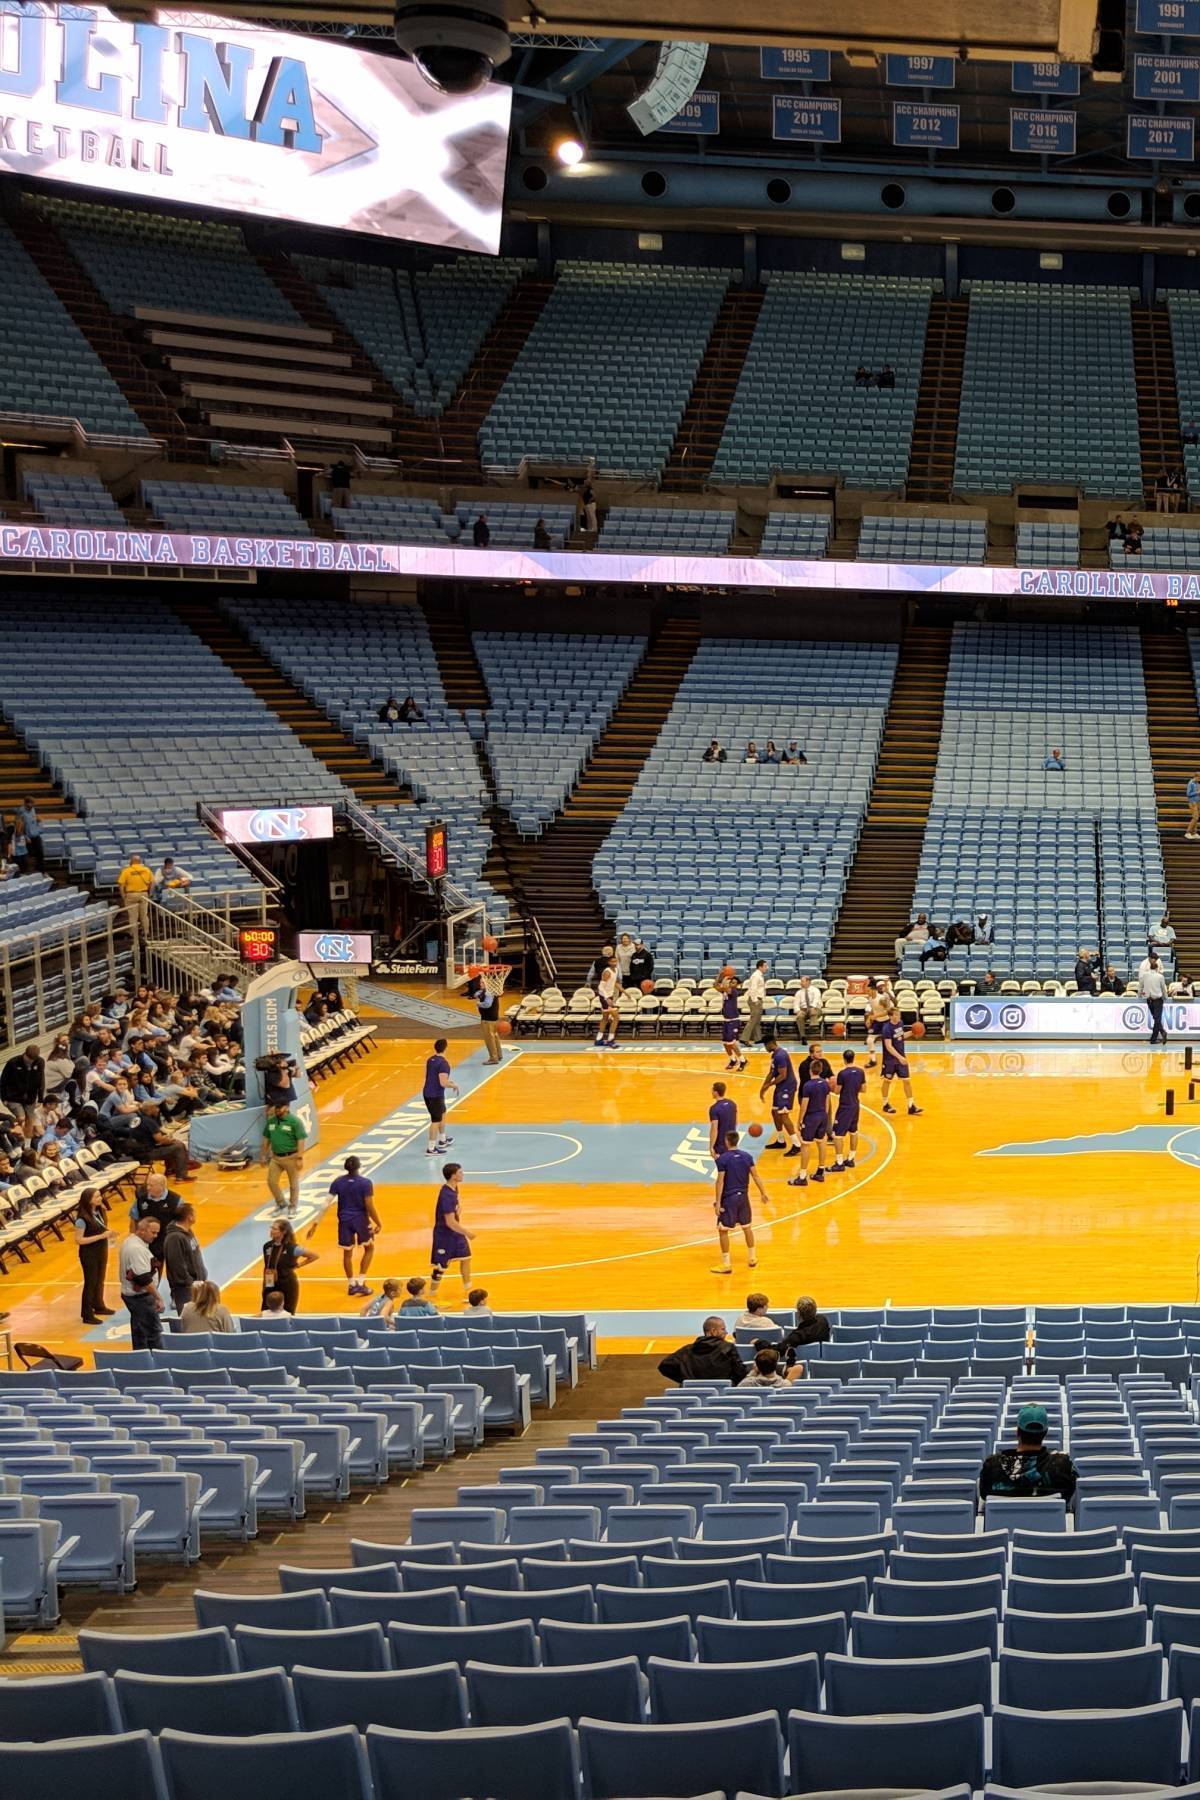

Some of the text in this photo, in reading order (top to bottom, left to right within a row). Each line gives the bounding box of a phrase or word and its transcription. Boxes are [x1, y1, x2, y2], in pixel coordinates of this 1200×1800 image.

[1158, 4, 1185, 18] 1991
[781, 49, 812, 64] 1995
[907, 56, 935, 70] 1997
[1137, 56, 1199, 69] ACC CHAMPIONS
[1032, 63, 1060, 77] 1998
[1154, 70, 1181, 84] 2001
[776, 99, 838, 111] ACC CHAMPIONS
[897, 105, 957, 117] ACC CHAMPIONS
[793, 112, 822, 125] 2011
[912, 118, 940, 131] 2012
[1013, 112, 1074, 124] ACC CHAMPIONS
[1132, 118, 1191, 130] ACC CHAMPIONS
[1029, 124, 1057, 137] 2016
[1148, 130, 1174, 144] 2017
[1, 528, 392, 572] CAROLINA BASKETBALL
[1020, 571, 1156, 598] CAROLINA
